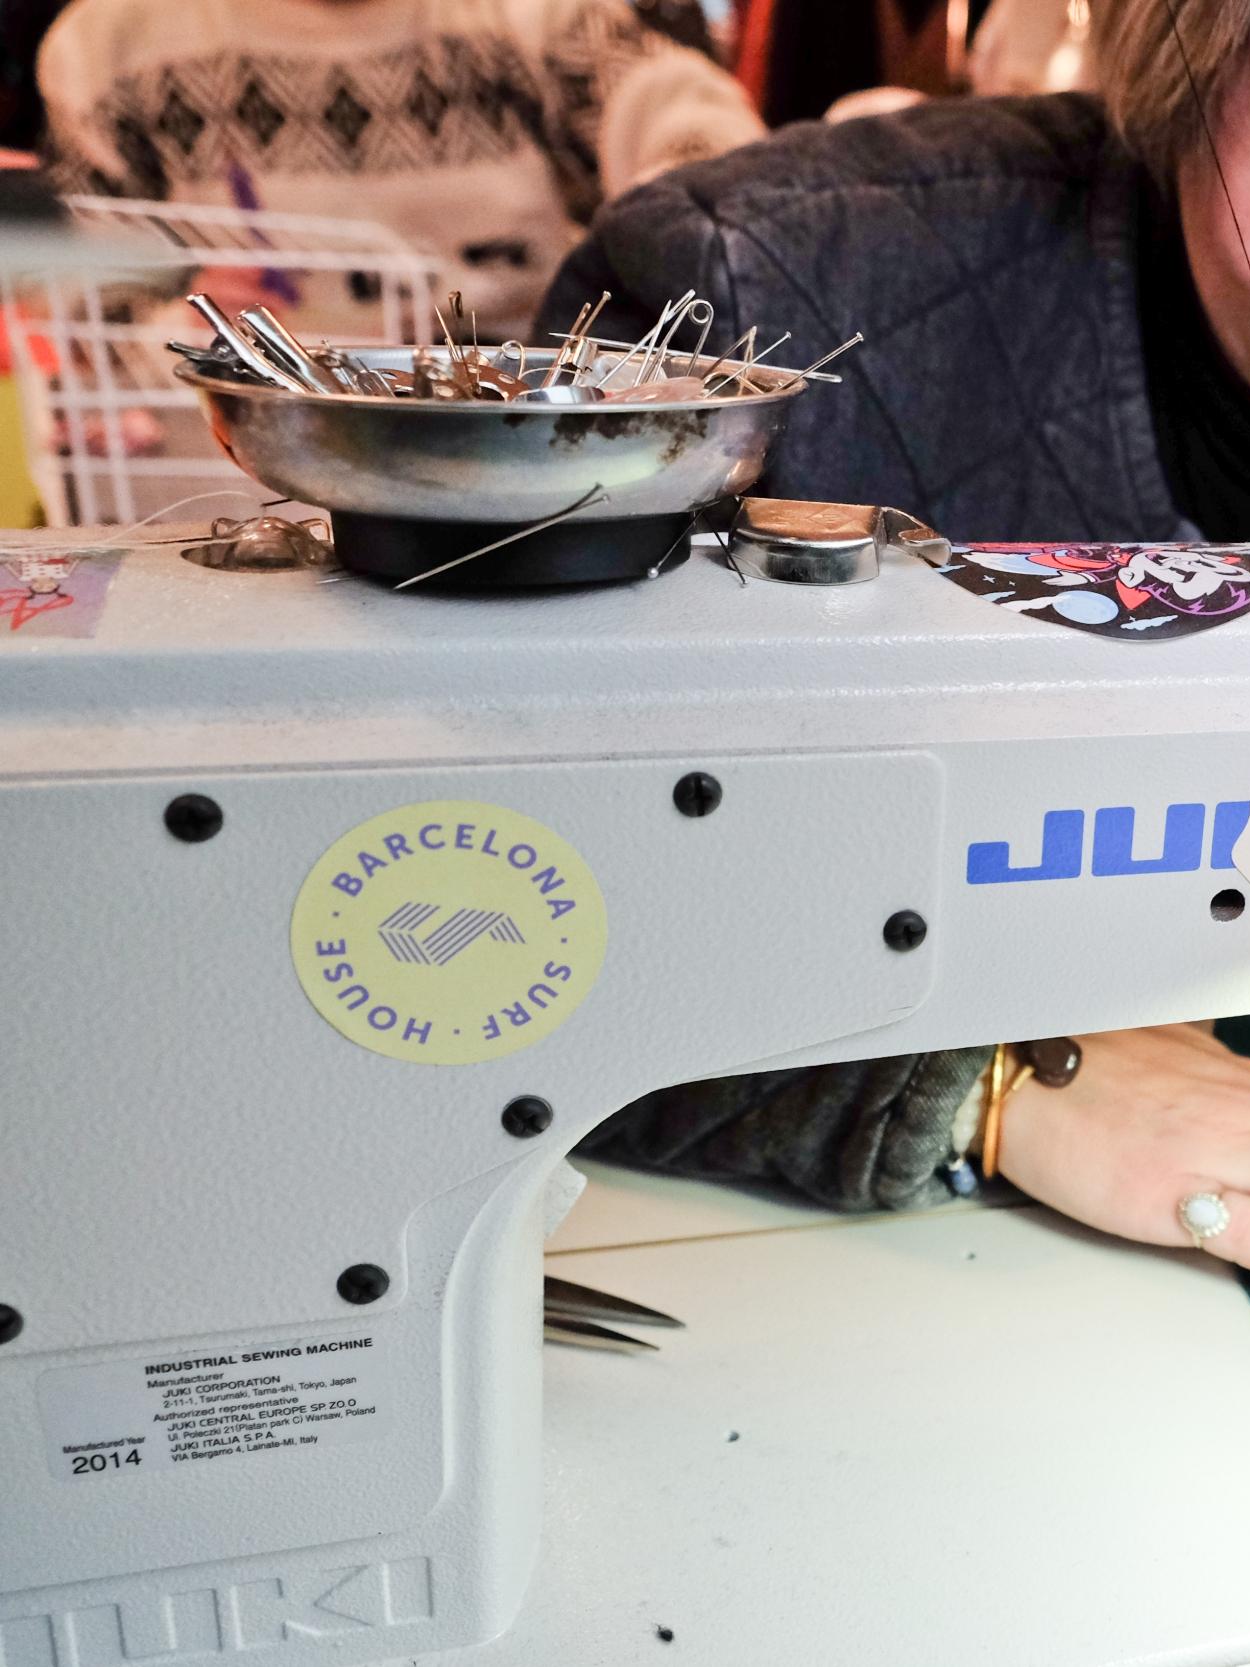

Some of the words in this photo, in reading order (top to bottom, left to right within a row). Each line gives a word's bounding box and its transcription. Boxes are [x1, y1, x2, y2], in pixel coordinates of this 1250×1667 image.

[331, 823, 576, 920] BARCELONA
[315, 939, 432, 1045] HOUSE
[481, 961, 572, 1040] SURF
[145, 1356, 238, 1375] INDUSTRIAL
[241, 1347, 302, 1363] SEWING
[306, 1338, 374, 1355] MACHINE
[147, 1372, 225, 1389] Manufacturer
[162, 1387, 191, 1398] JUKI
[195, 1375, 281, 1394] CORPORATION
[330, 1376, 357, 1388] Japan
[153, 1407, 216, 1422] Authorized
[219, 1397, 299, 1413] representative
[167, 1420, 196, 1432] JUKI
[199, 1412, 256, 1428] CENTRAL
[258, 1405, 308, 1419] EUROPE
[270, 1418, 291, 1429] park
[345, 1406, 376, 1417] Poland
[170, 1441, 199, 1453] JUKI
[203, 1435, 240, 1448] ITALIA
[171, 1452, 189, 1462] VIA
[191, 1447, 234, 1460] Bergamo
[300, 1435, 318, 1446] Italy
[72, 1449, 142, 1474] 2014
